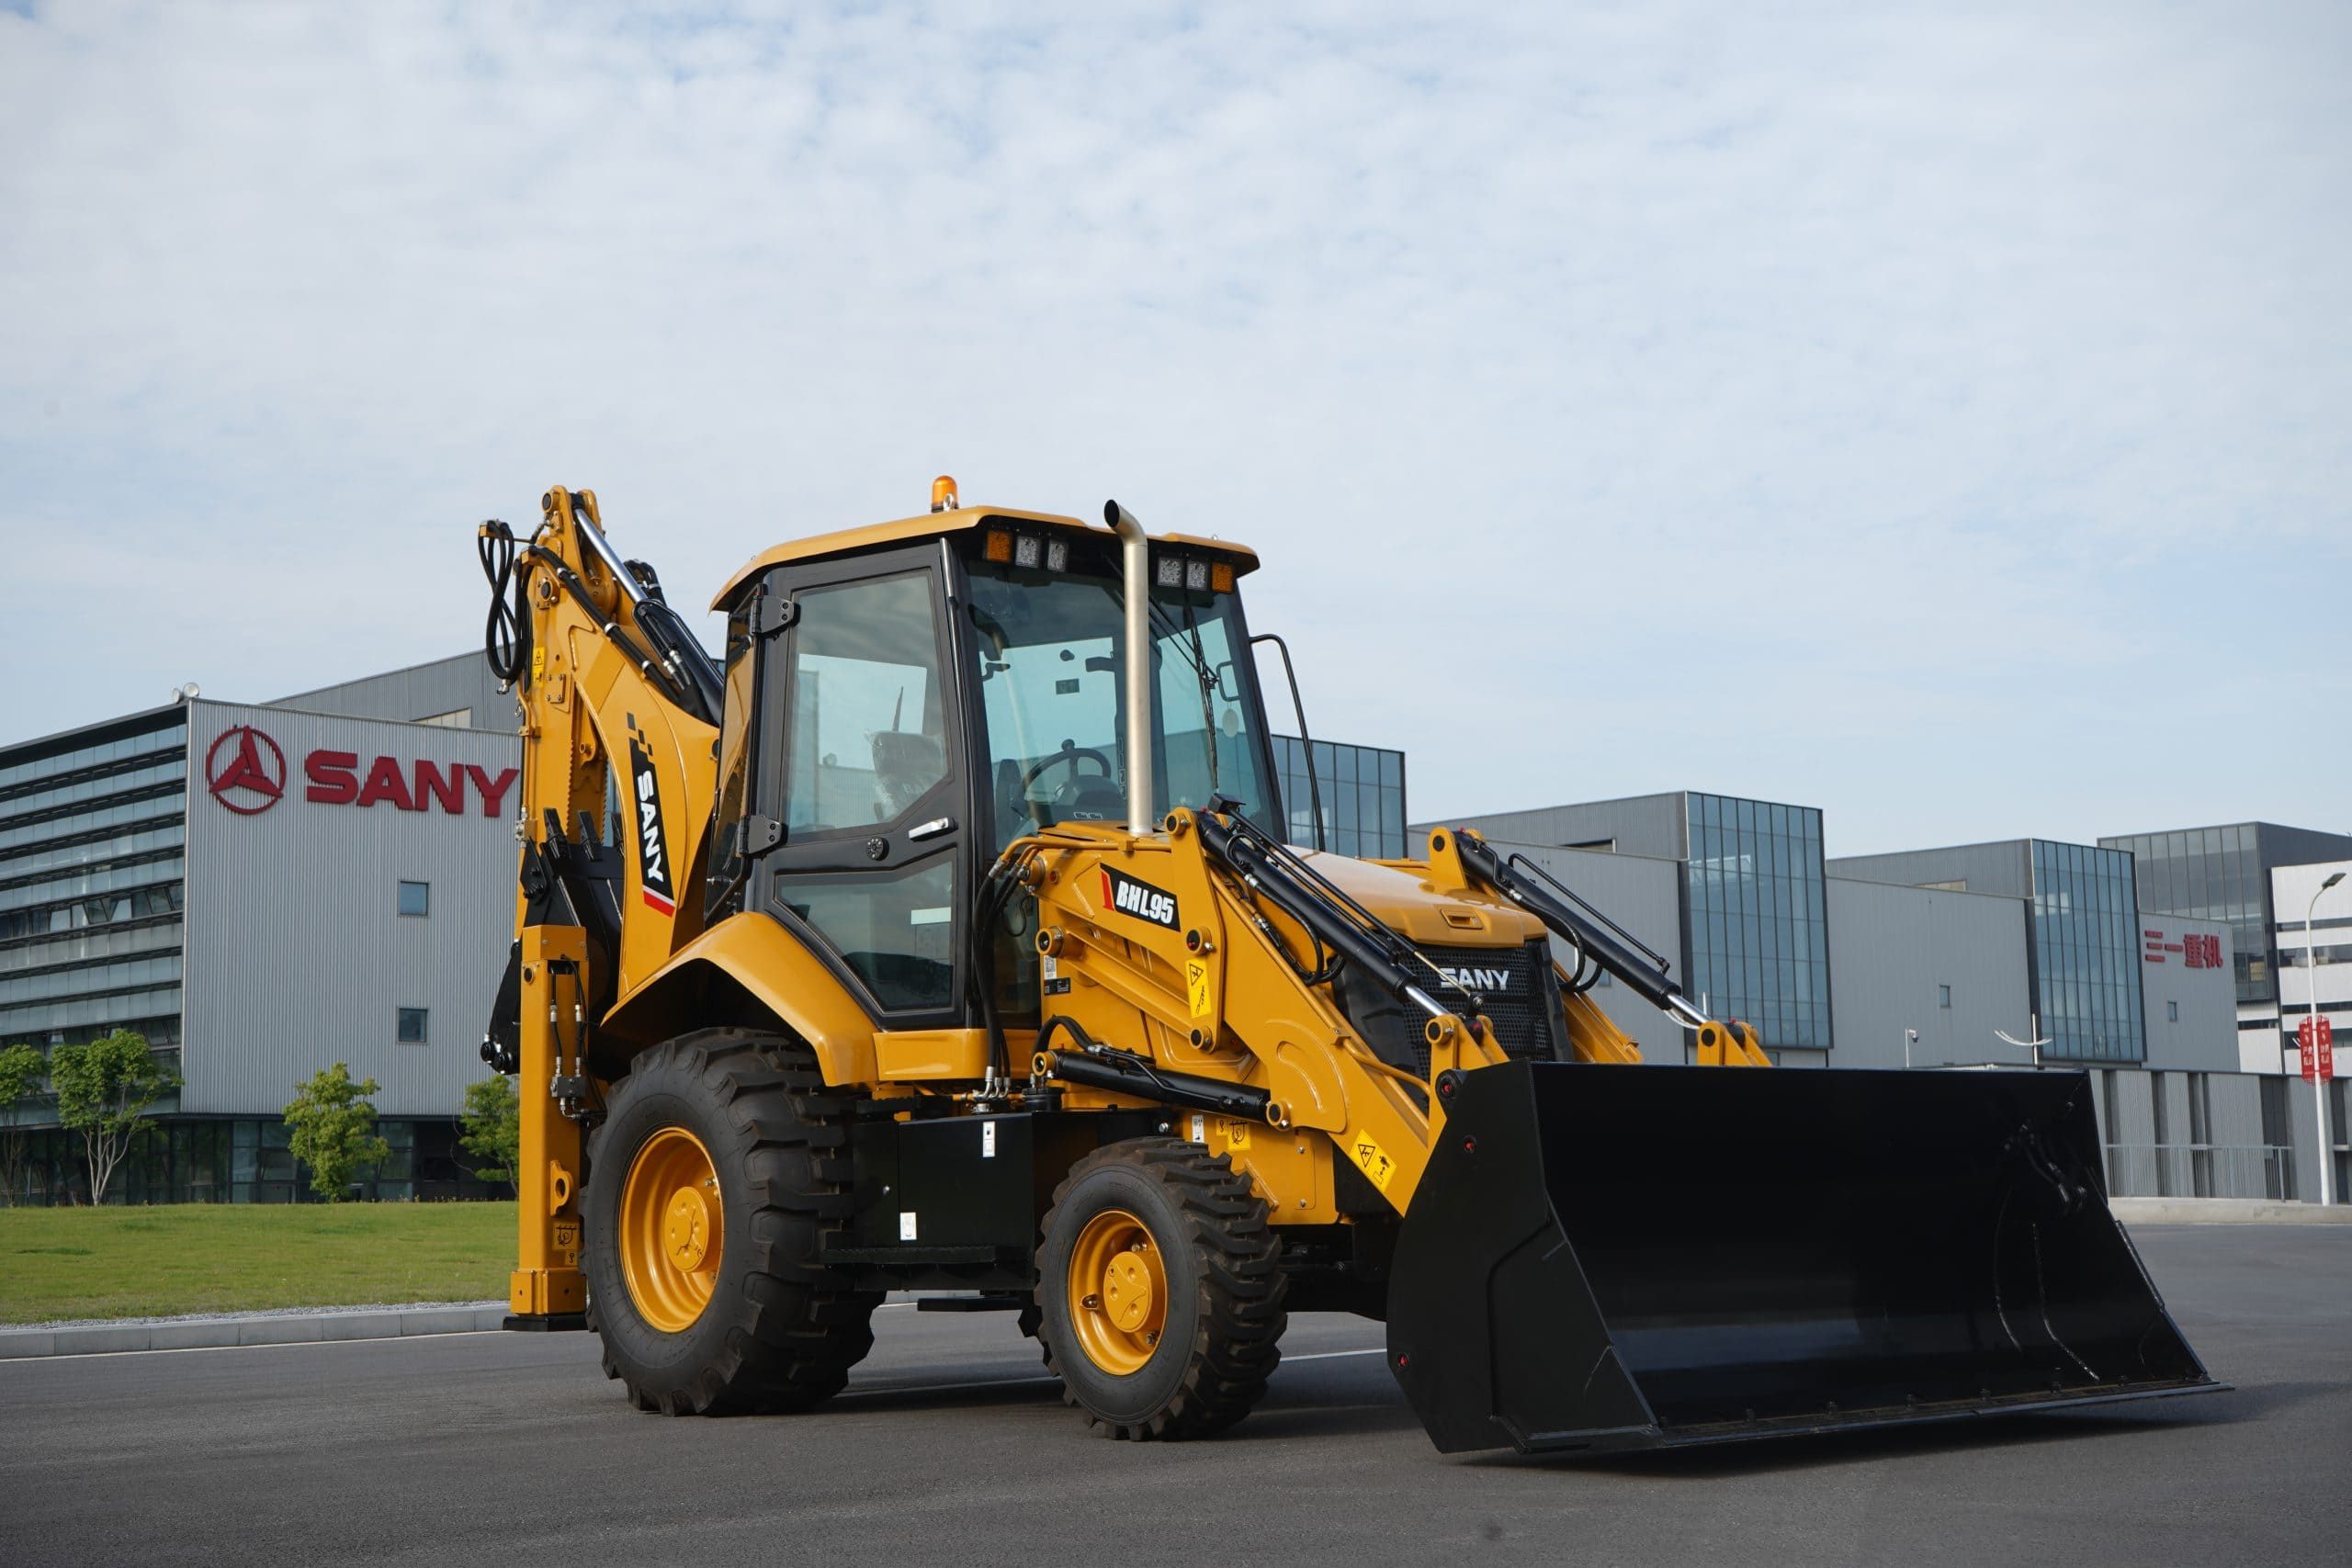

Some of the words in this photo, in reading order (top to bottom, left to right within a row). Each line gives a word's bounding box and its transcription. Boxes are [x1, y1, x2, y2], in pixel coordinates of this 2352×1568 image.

[304, 750, 521, 818] SANY
[638, 770, 664, 883] SANY
[1115, 880, 1175, 924] BHL95
[2144, 930, 2223, 969] 三一重机
[1440, 967, 1510, 991] SANY
